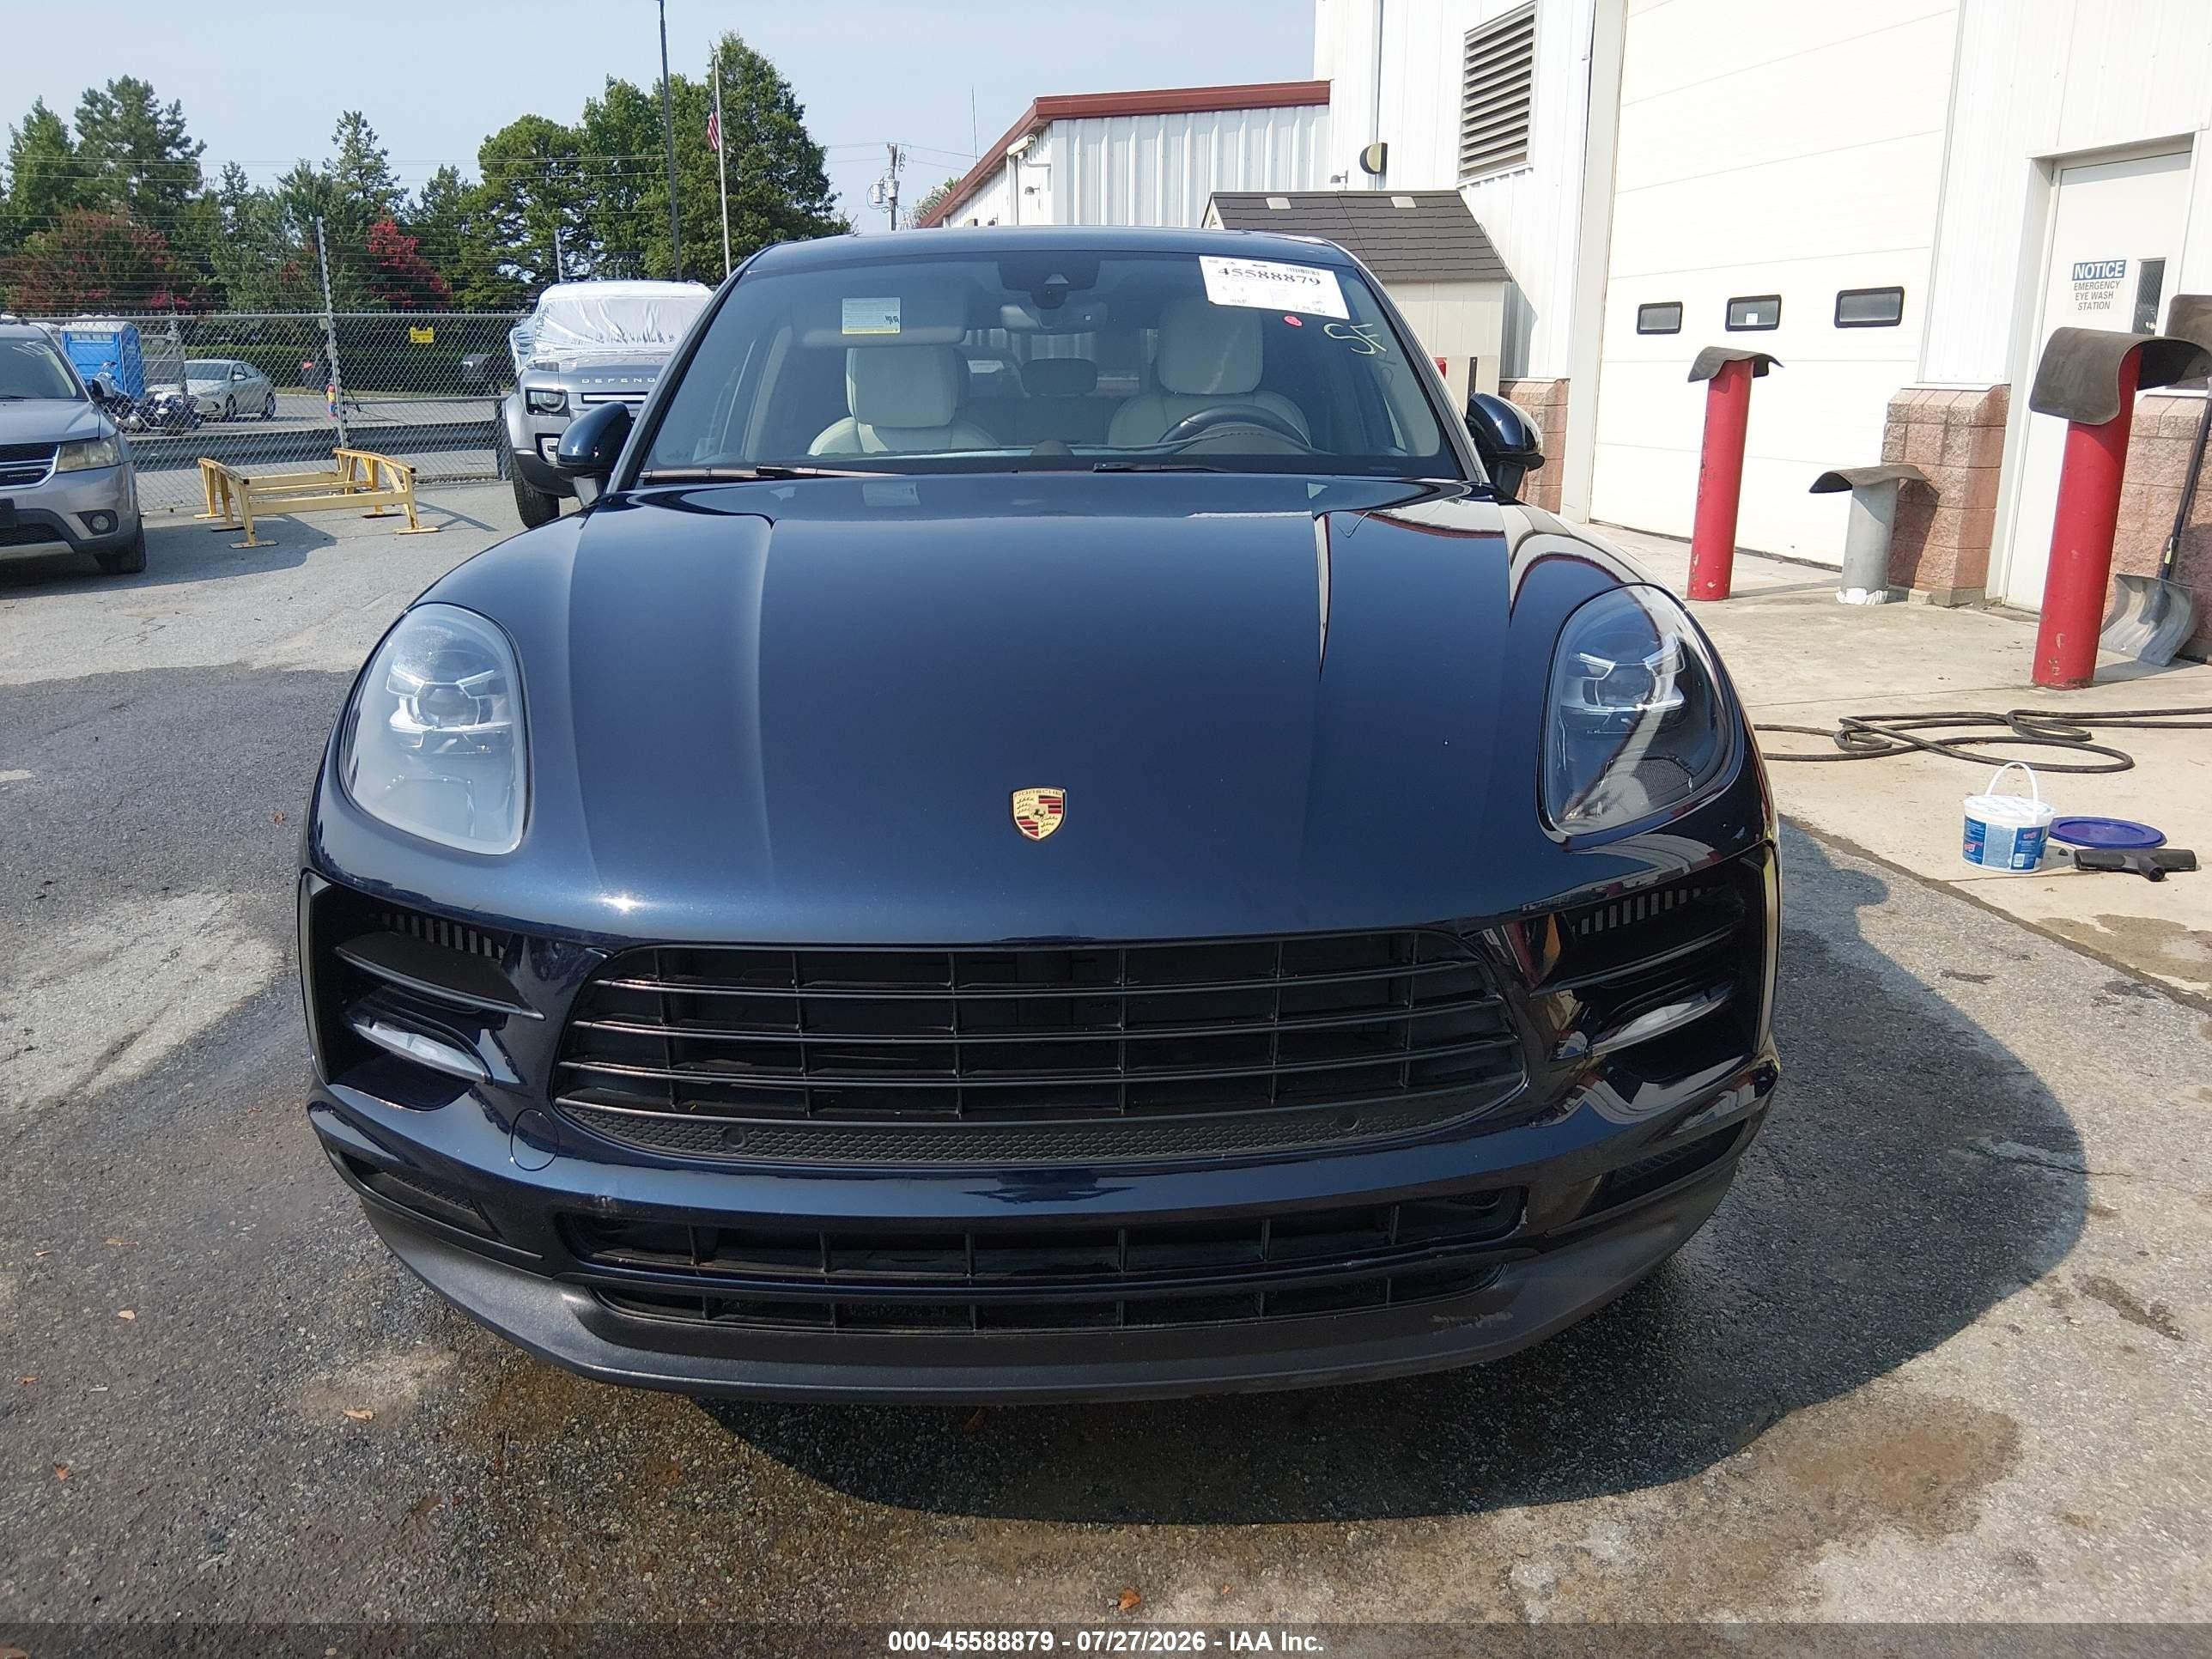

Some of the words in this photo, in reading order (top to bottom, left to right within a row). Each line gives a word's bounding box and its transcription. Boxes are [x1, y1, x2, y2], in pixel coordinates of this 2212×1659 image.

[2074, 261, 2124, 279] NOTICE
[1218, 267, 1321, 286] 45588879
[2074, 280, 2121, 291] EMERGENCY
[2075, 292, 2089, 301] EYE
[2091, 290, 2114, 301] WASH
[2077, 301, 2111, 311] STATION
